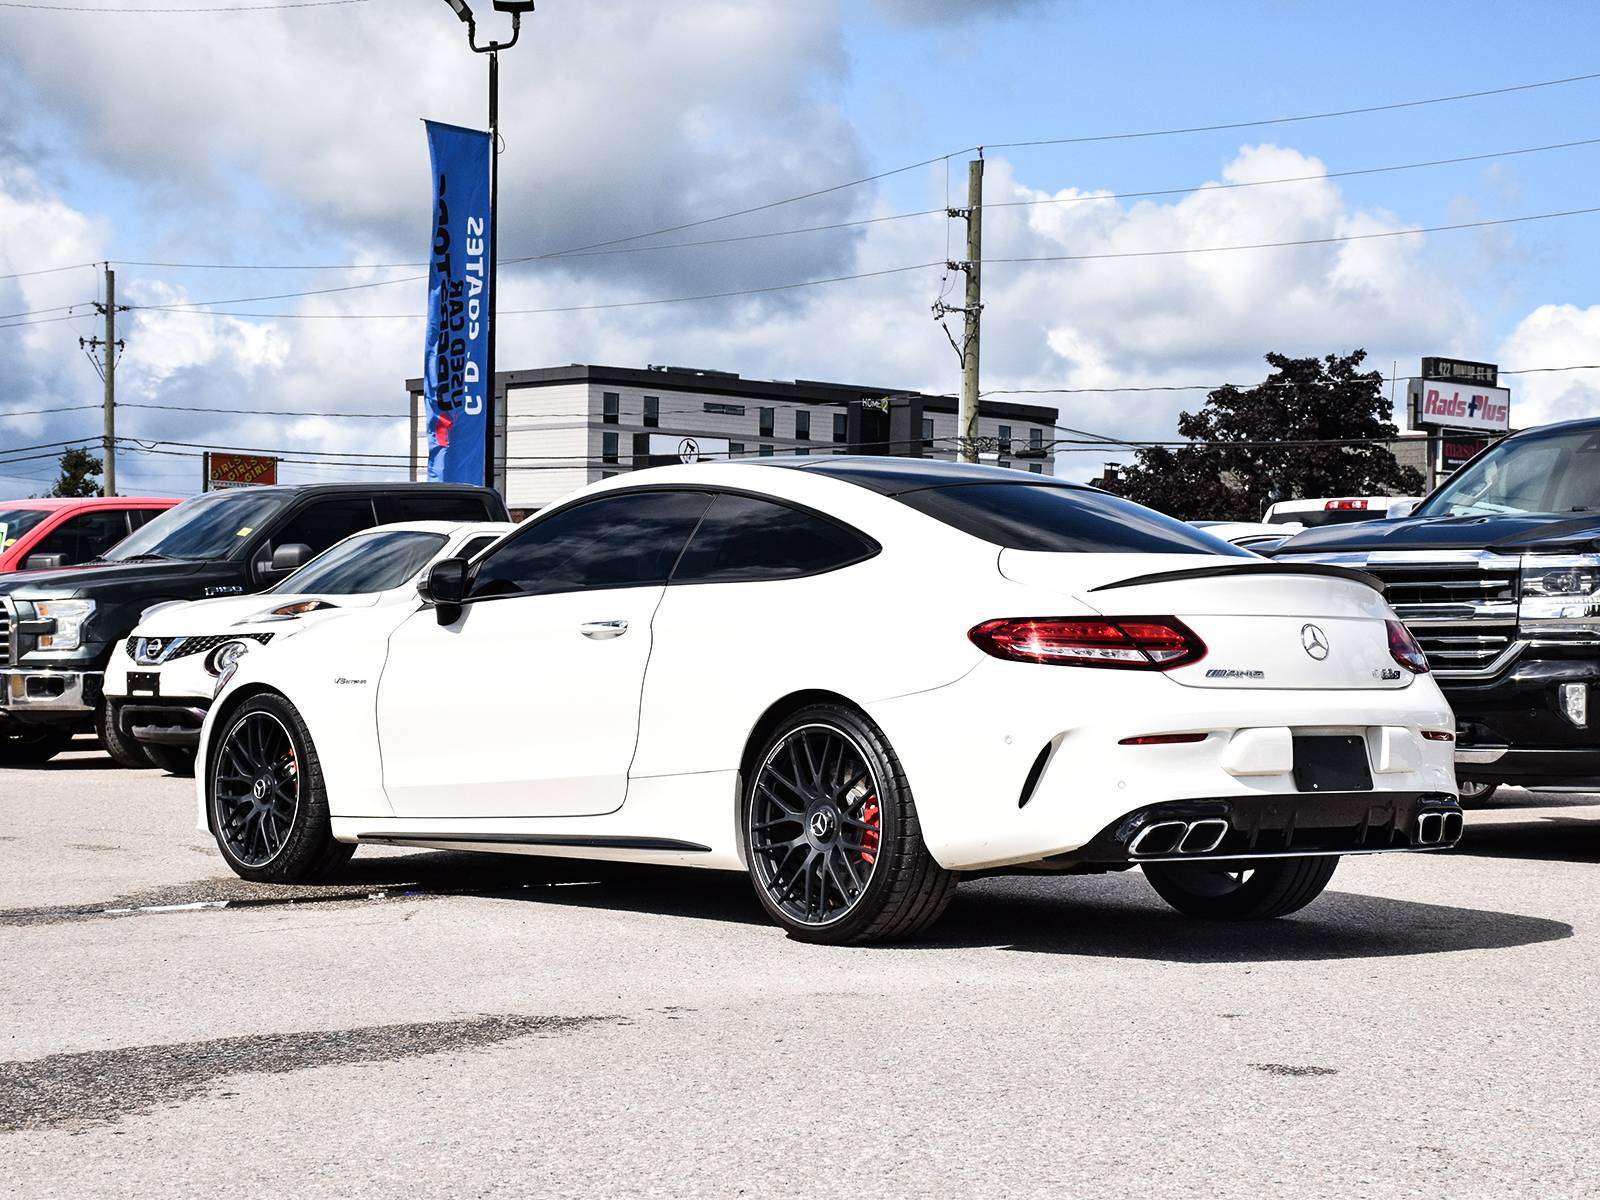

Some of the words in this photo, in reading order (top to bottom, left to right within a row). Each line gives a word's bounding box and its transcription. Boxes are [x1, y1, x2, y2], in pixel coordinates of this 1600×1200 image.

[1425, 389, 1467, 417] Rads
[1468, 394, 1507, 422] Plus
[211, 455, 241, 480] GIRLS
[228, 455, 257, 480] GIRLS
[245, 457, 273, 482] GIRLS
